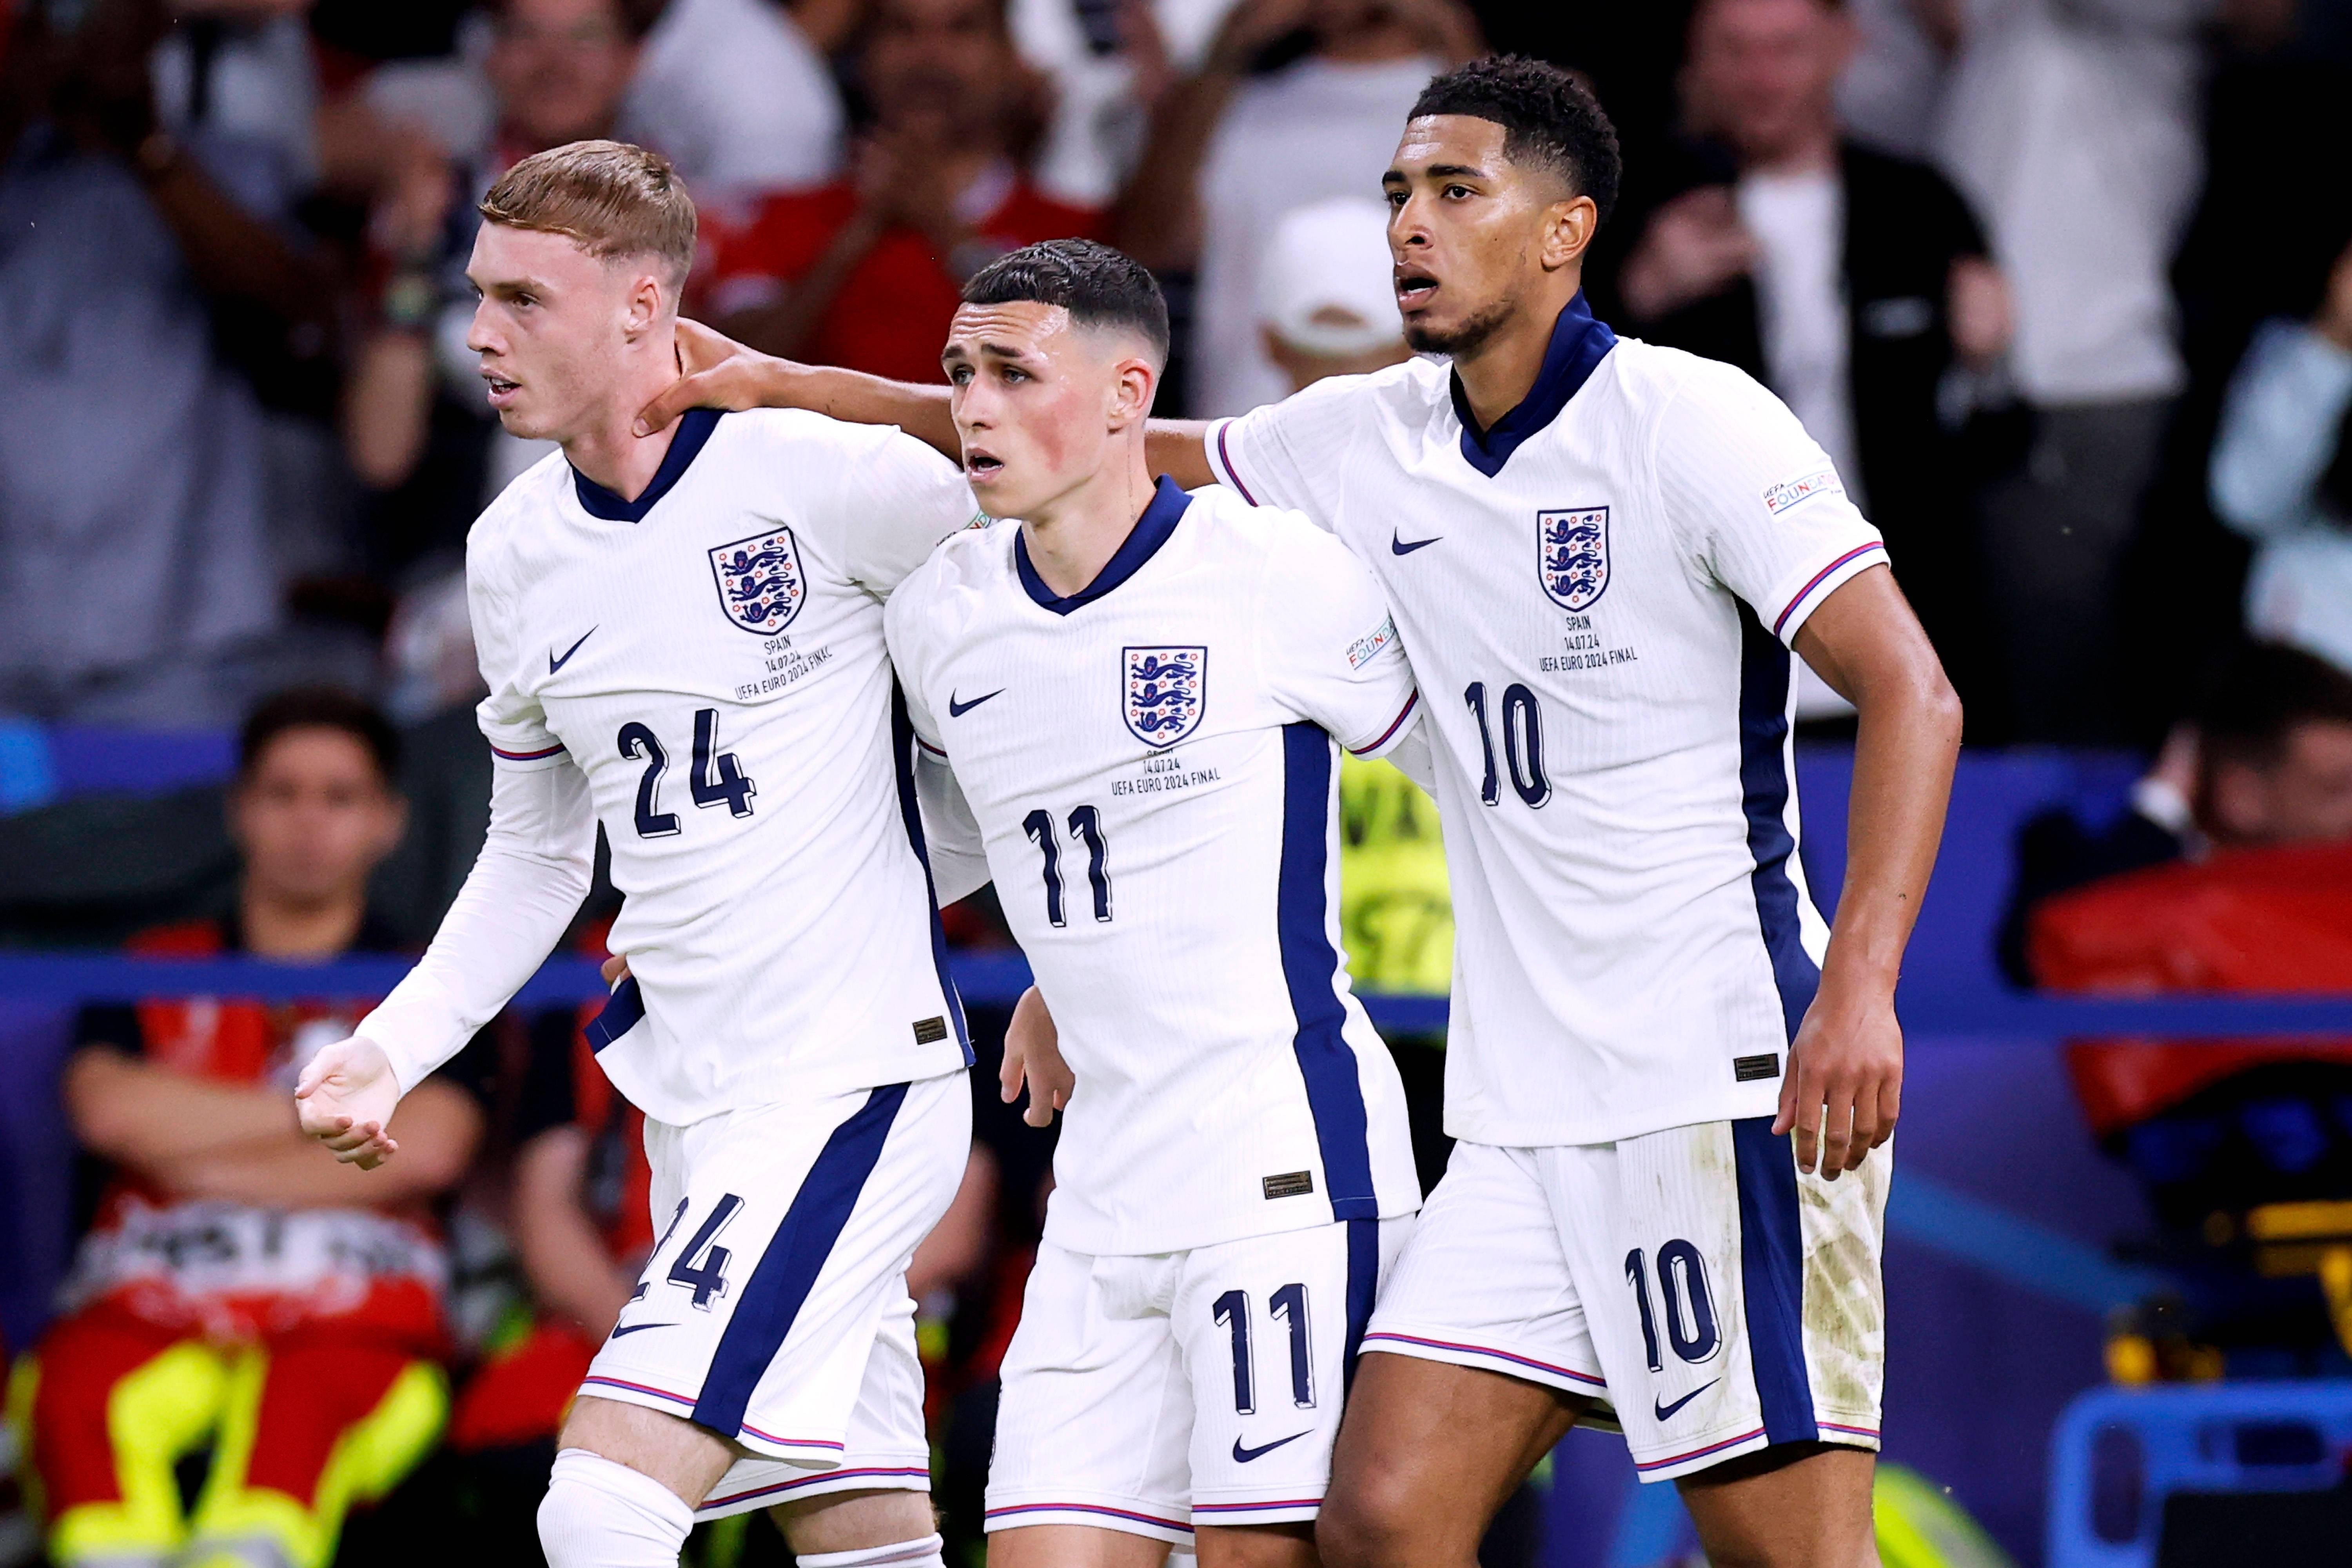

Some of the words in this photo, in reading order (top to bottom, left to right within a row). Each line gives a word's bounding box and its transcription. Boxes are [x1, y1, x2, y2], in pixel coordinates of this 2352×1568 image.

[1763, 483, 1785, 499] UEFA
[1566, 615, 1591, 631] SPAIN
[764, 635, 791, 655] SPAIN
[1346, 638, 1364, 655] UEFA
[1564, 633, 1599, 651] 14.07.24
[766, 650, 801, 673] 14.07.24
[1539, 657, 1559, 671] UEFA
[1561, 655, 1583, 671] EURO
[1585, 652, 1608, 668] 2024
[1609, 646, 1638, 665] FINAL
[735, 683, 760, 700] UEFA
[762, 674, 786, 693] EURO
[788, 661, 808, 682] 2024
[808, 646, 833, 669] FINAL
[1464, 681, 1552, 809] 10
[617, 707, 757, 839] 24
[1143, 758, 1180, 774] 14.07.24
[1112, 780, 1134, 795] UEFA
[1137, 777, 1161, 793] EURO
[1164, 774, 1189, 789] 2024
[1191, 768, 1221, 786] FINAL
[1022, 804, 1113, 928] 11
[1625, 1238, 1724, 1373] 10
[1212, 1282, 1317, 1416] 11
